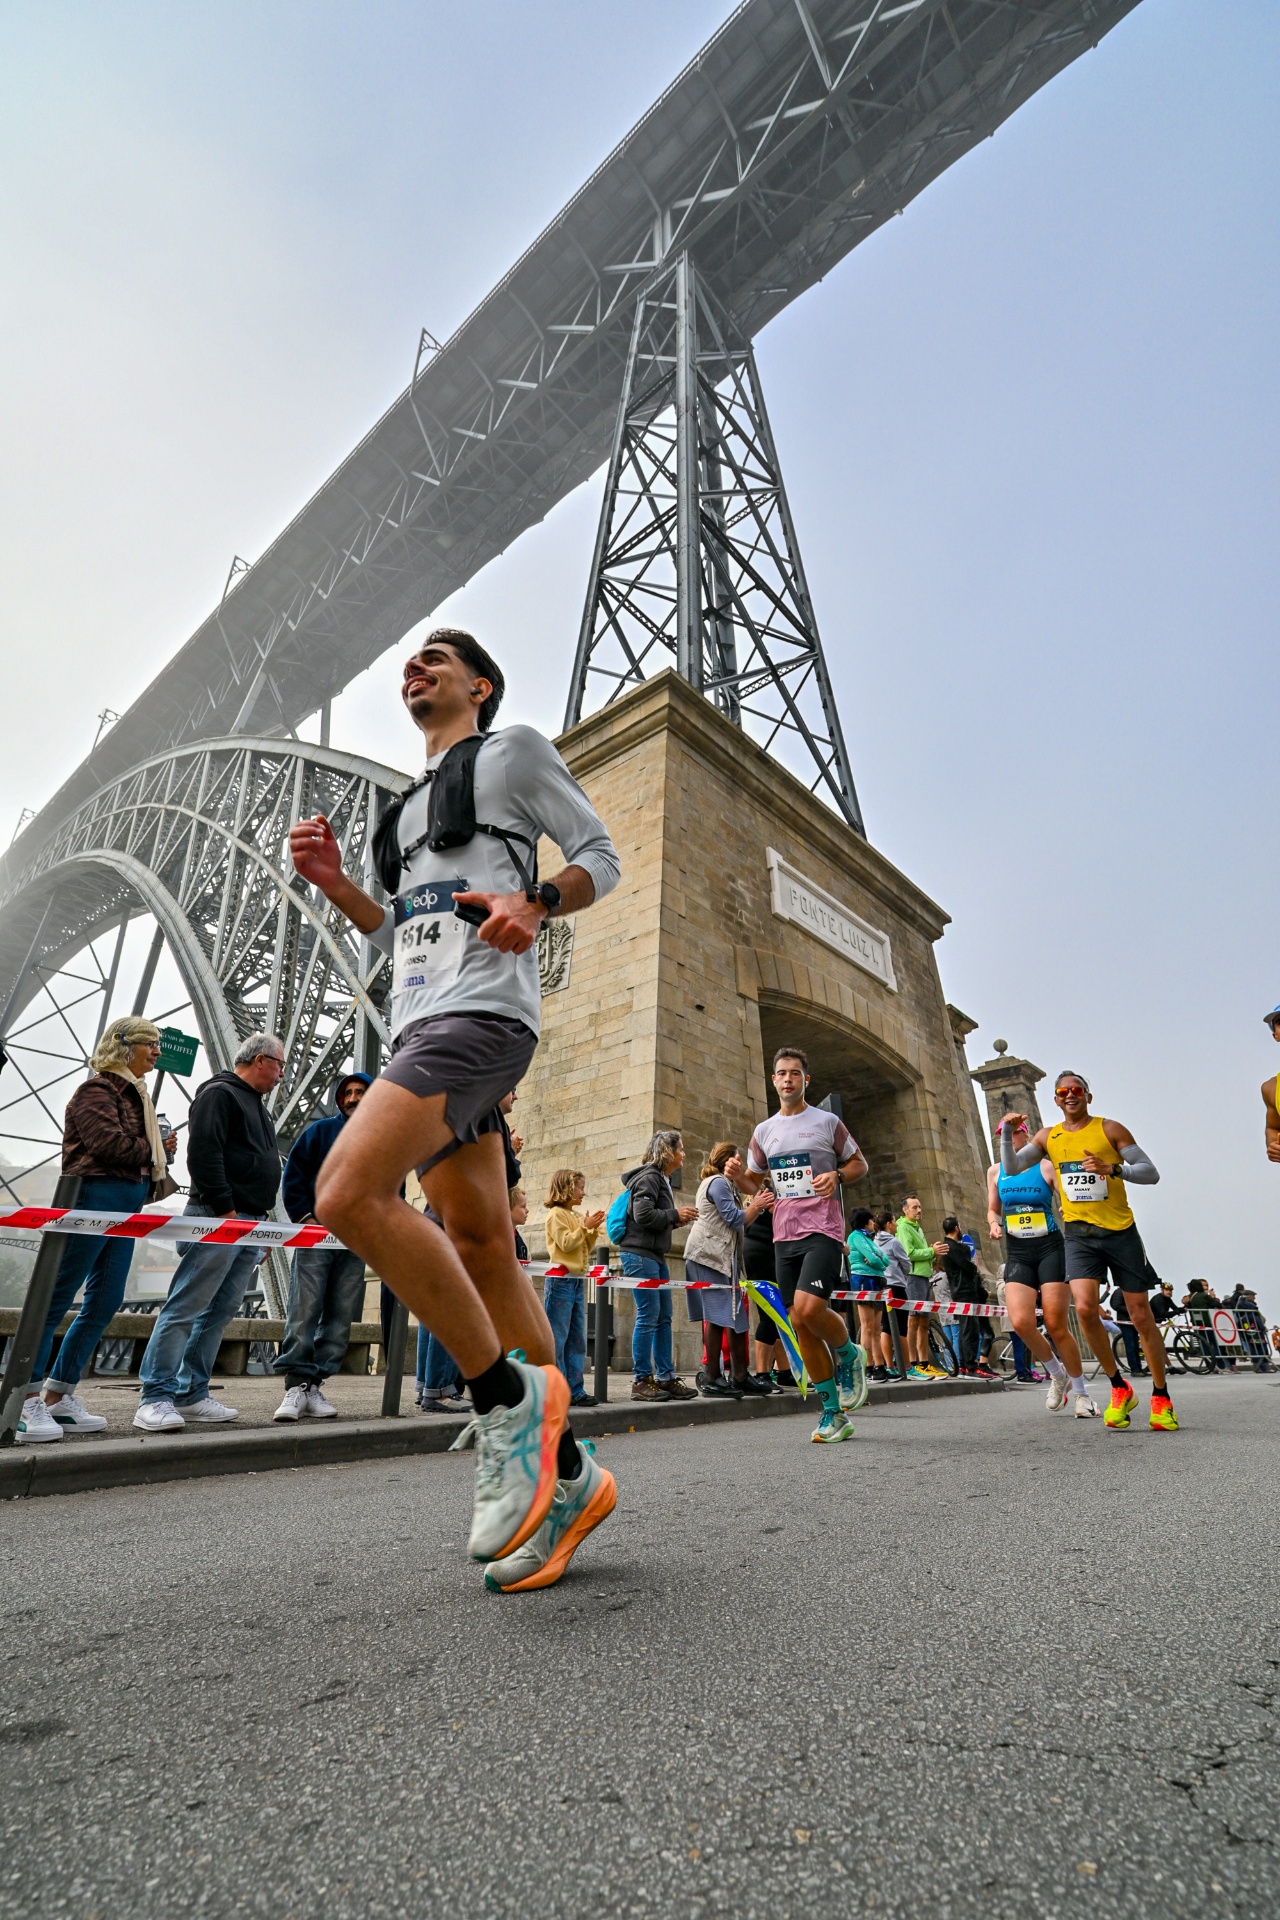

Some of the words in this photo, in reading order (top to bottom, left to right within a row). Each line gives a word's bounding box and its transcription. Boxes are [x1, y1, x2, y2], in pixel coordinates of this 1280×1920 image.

[413, 888, 438, 910] edp
[840, 922, 869, 958] LUIZ
[173, 1044, 194, 1056] EIFFEL
[777, 1170, 803, 1182] 3849
[1067, 1175, 1096, 1186] 2738
[1001, 1186, 1042, 1195] SPARTA
[30, 1216, 64, 1226] DMM
[73, 1218, 85, 1226] C.
[88, 1220, 102, 1228] M.
[106, 1221, 149, 1231] PORTO
[1019, 1216, 1032, 1225] 89
[191, 1226, 219, 1236] DMM
[249, 1230, 283, 1240] PORTO
